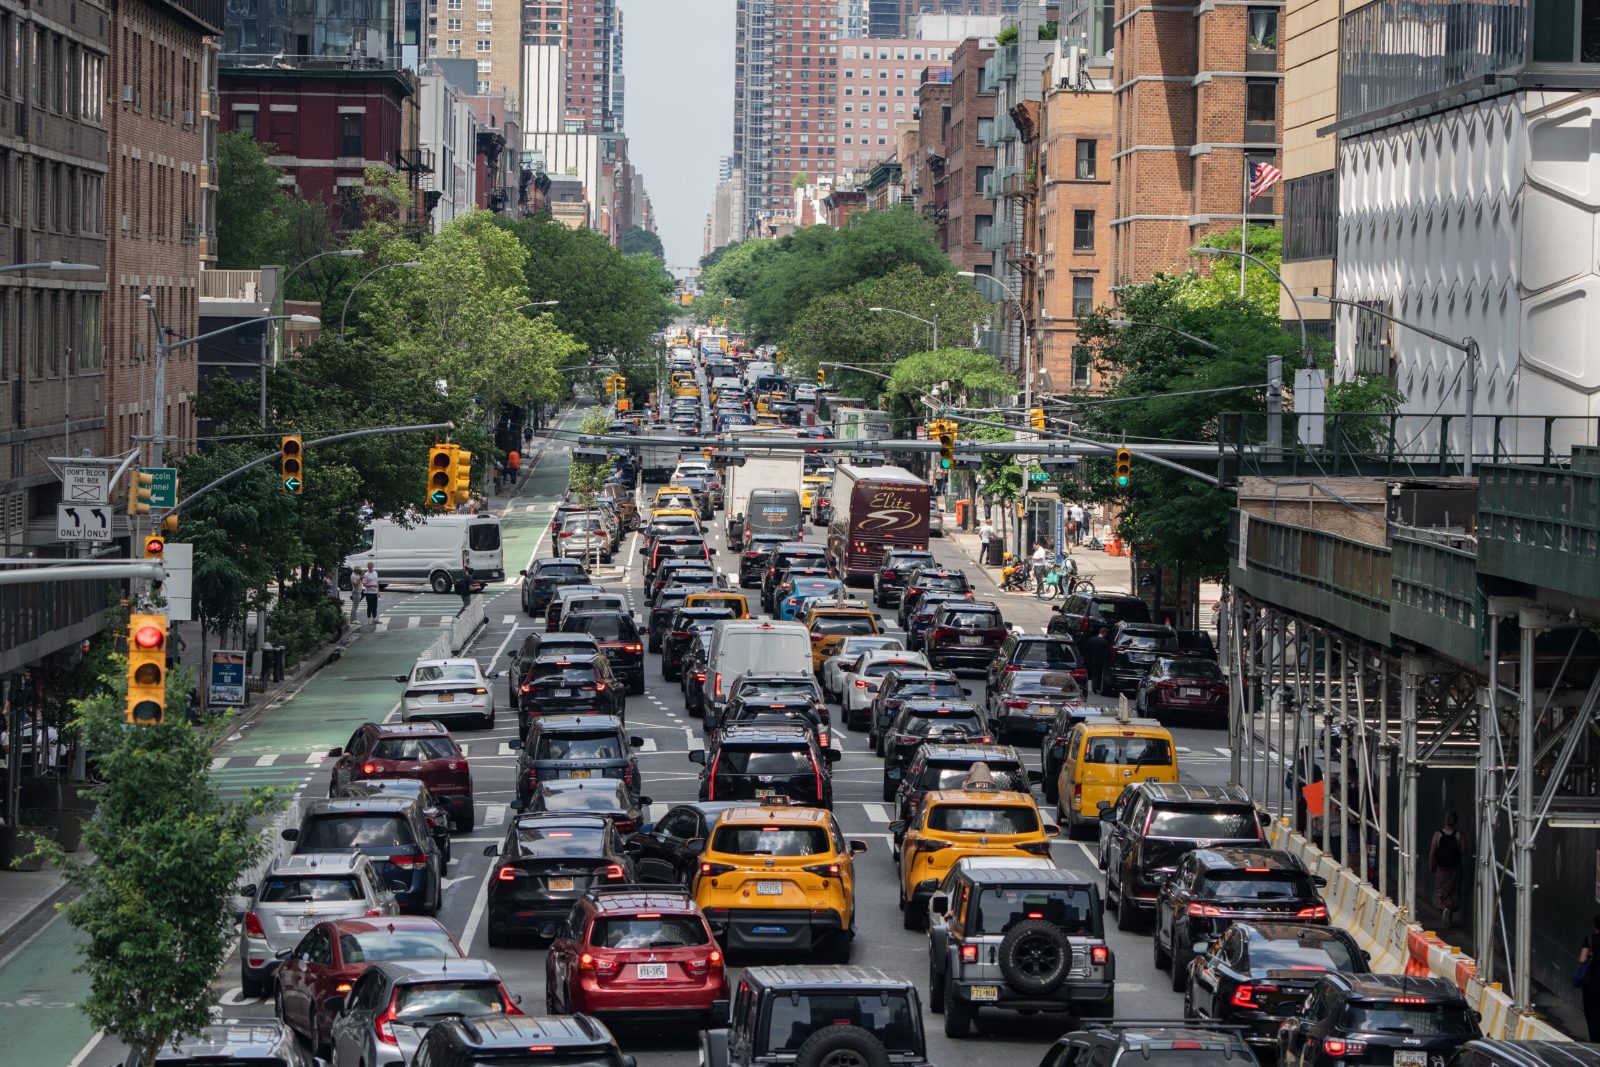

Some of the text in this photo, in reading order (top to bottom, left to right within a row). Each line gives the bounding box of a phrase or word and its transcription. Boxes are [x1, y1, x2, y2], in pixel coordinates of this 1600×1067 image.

[86, 469, 106, 477] BLOCK
[869, 492, 912, 510] Elite
[60, 529, 82, 537] ONLY
[1402, 1036, 1421, 1045] Jeep
